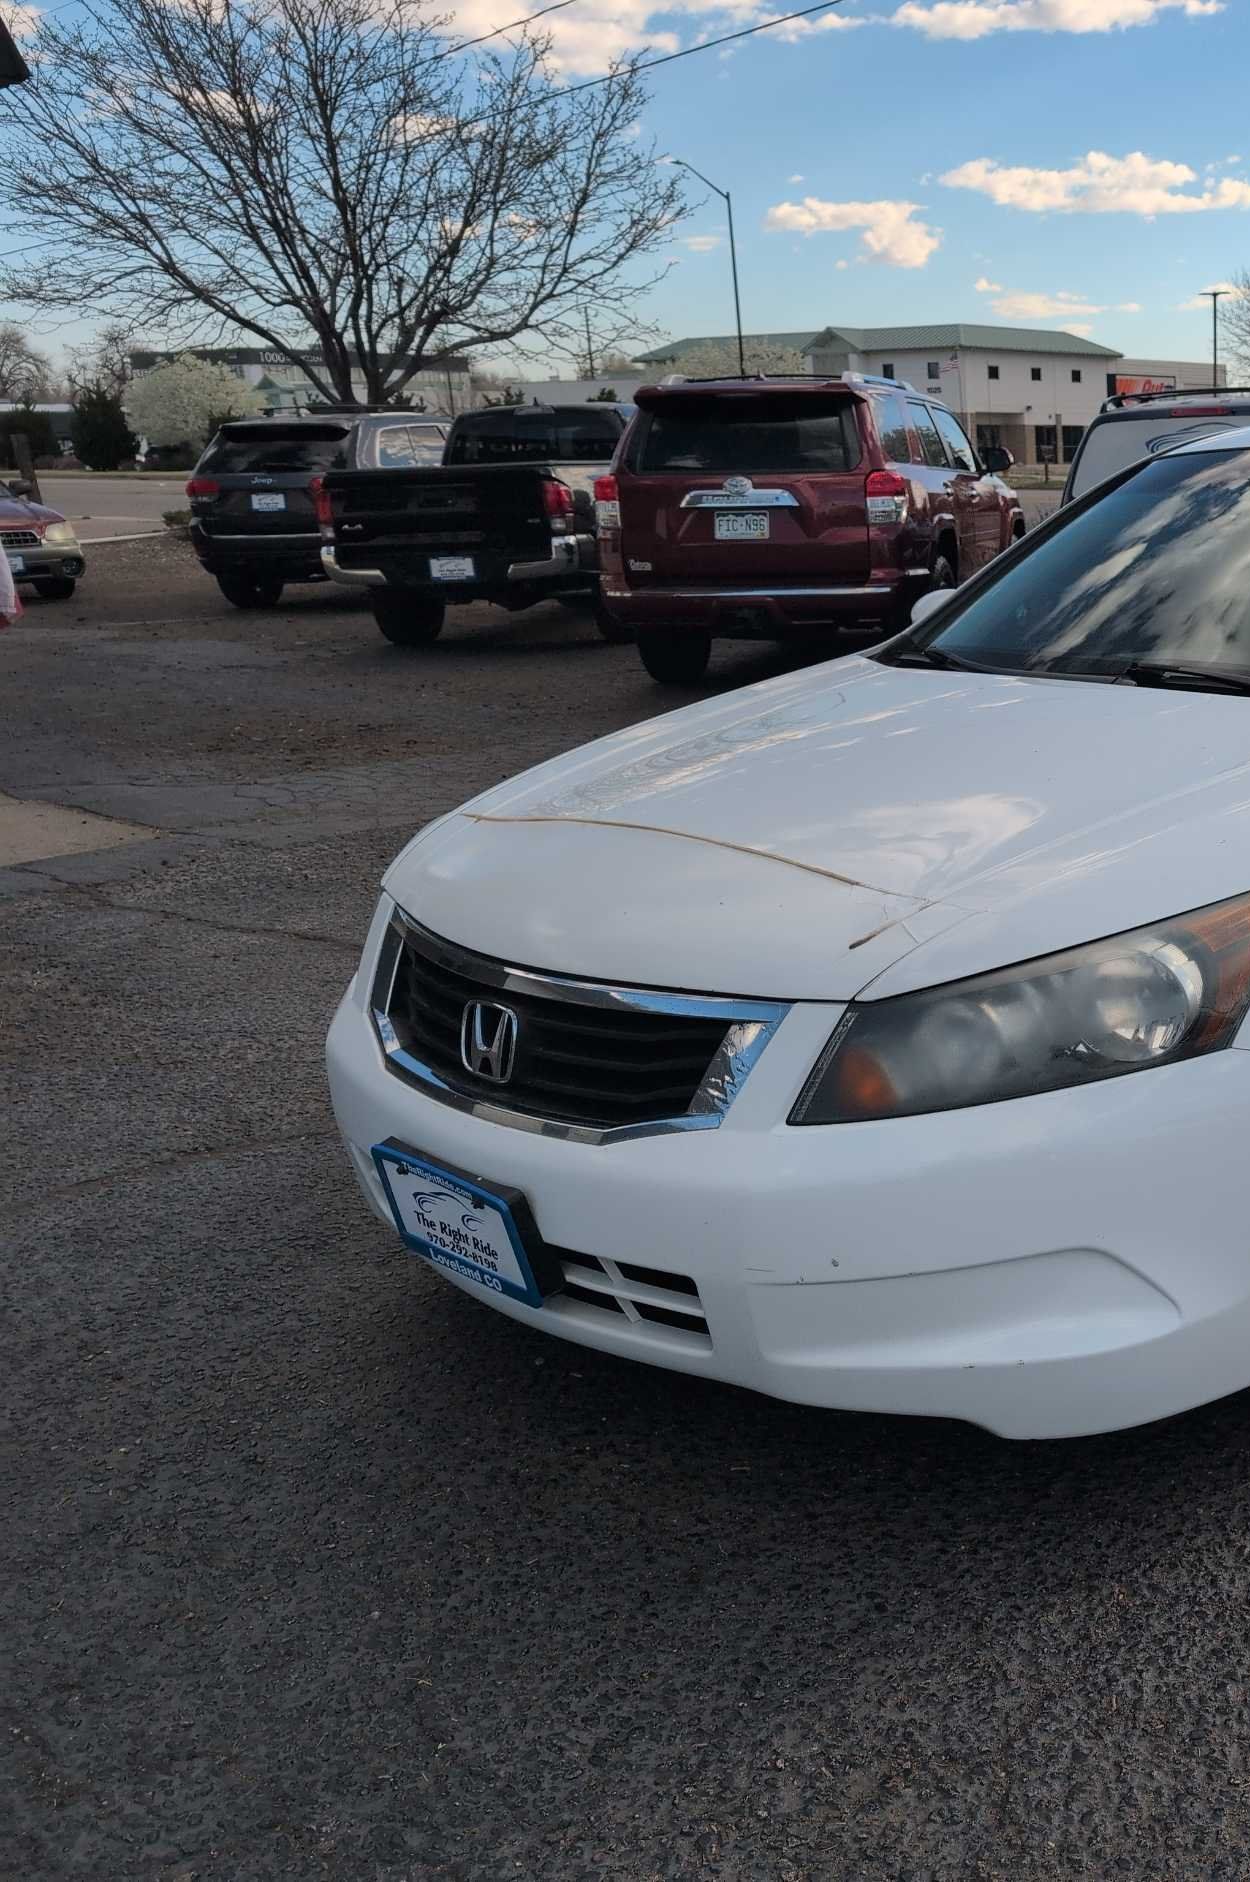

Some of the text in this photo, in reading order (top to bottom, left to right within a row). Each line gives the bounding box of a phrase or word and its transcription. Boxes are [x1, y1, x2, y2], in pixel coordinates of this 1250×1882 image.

[414, 1210, 499, 1260] The Right Ride
[426, 1231, 498, 1272] 970-292-8198
[429, 1247, 503, 1292] Loveland CO
